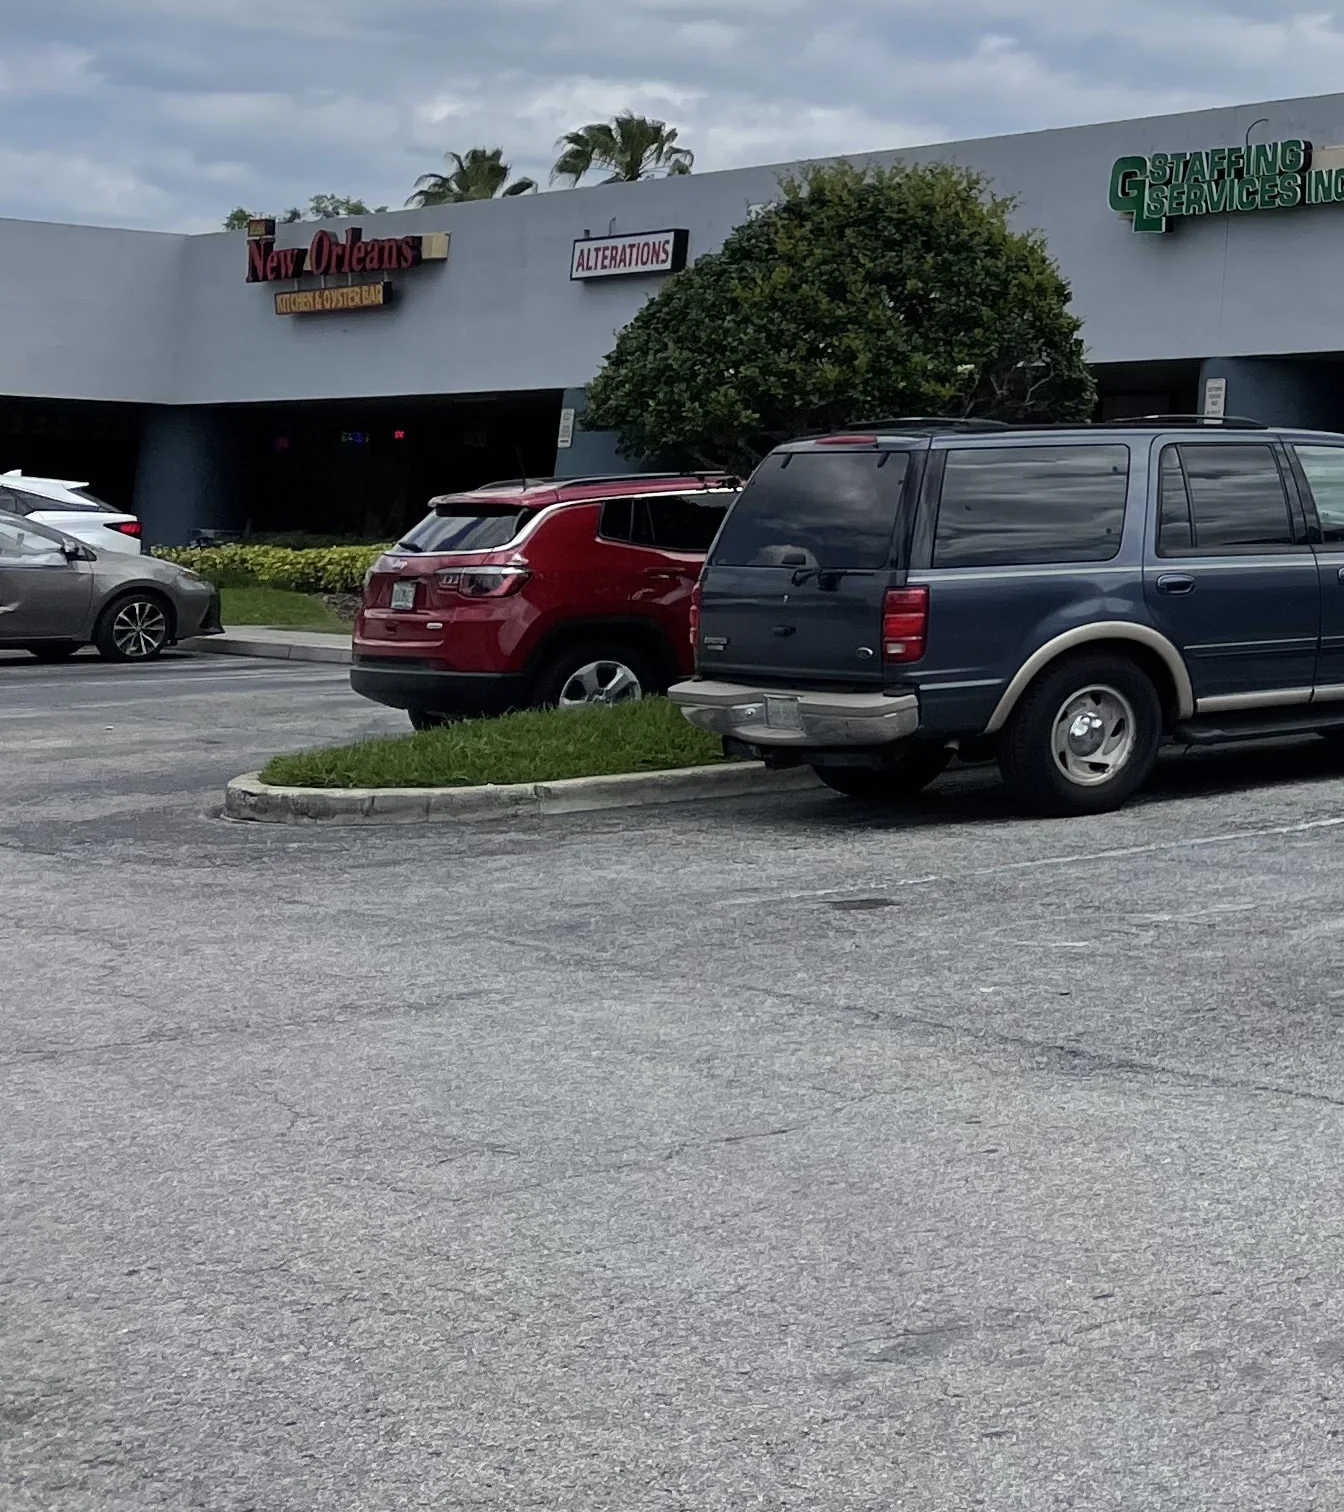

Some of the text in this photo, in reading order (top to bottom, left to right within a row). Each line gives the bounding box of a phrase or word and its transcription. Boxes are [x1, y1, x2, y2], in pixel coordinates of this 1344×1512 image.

[1149, 139, 1305, 184] STAFFING
[1146, 173, 1301, 218] SERVICES
[247, 227, 415, 281] New Orleans
[575, 240, 670, 273] ALTERATIONS
[278, 284, 383, 314] KITCHEN & OYSTER BAR
